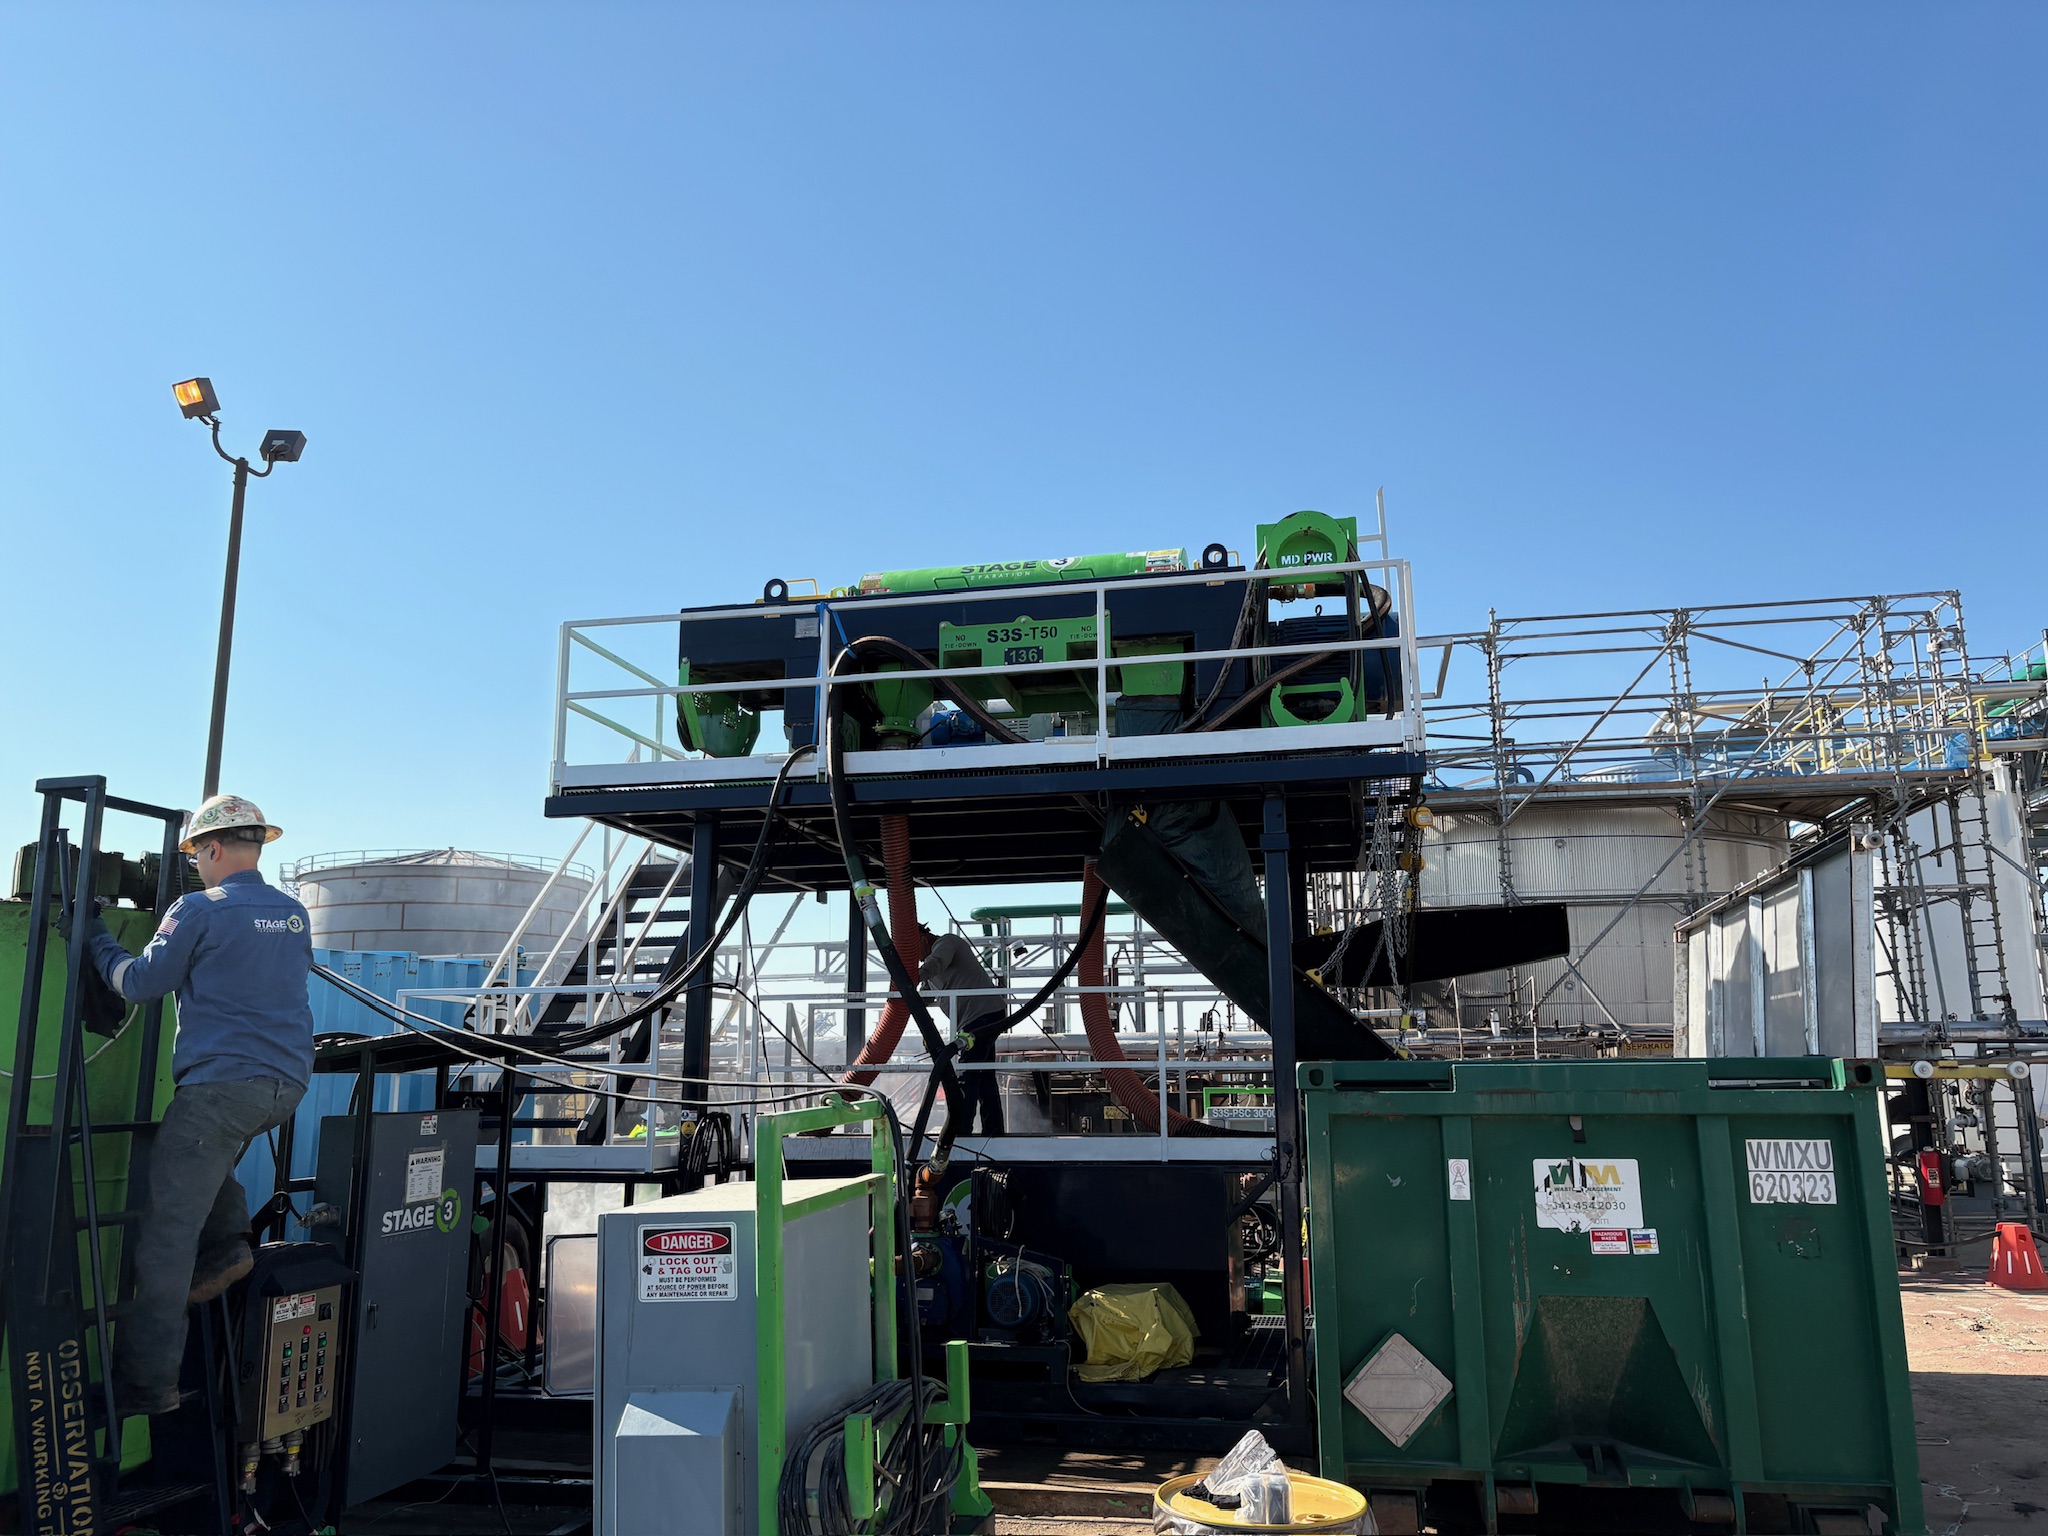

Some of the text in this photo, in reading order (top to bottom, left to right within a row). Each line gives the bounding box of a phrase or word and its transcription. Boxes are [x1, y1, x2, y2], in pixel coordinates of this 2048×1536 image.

[1281, 552, 1333, 565] MD PWR
[961, 560, 1037, 574] STAGE
[970, 571, 1031, 580] EPARATION
[987, 626, 1058, 643] S3S-T50
[1009, 649, 1038, 663] 136
[254, 919, 300, 929] STAGE 3
[1212, 1108, 1252, 1118] S3S-PSC
[415, 1155, 441, 1165] WARNING
[1747, 1141, 1831, 1170] WMXU
[1753, 1173, 1832, 1202] 620323
[381, 1200, 453, 1233] STAGE 3
[660, 1235, 713, 1249] DANGER
[659, 1256, 716, 1266] LOCK OUT
[657, 1266, 718, 1275] & TAG OUT
[26, 1351, 43, 1391] NOT
[29, 1399, 44, 1412] A
[32, 1415, 52, 1519] WORKING
